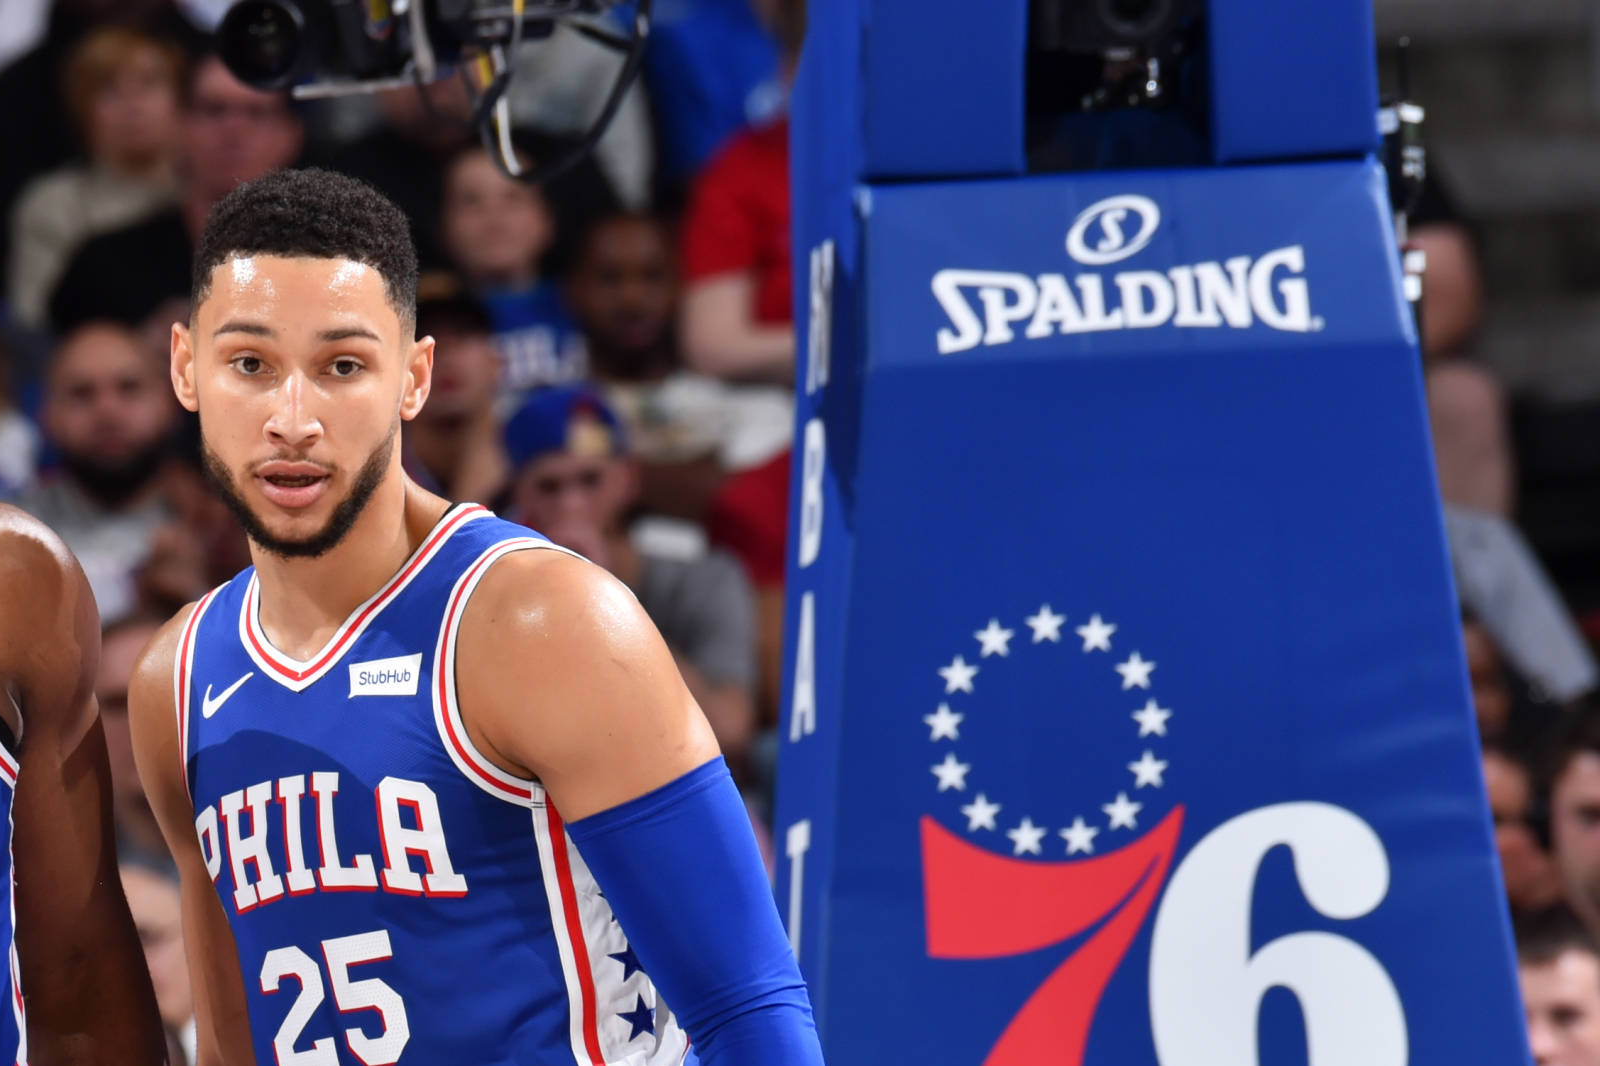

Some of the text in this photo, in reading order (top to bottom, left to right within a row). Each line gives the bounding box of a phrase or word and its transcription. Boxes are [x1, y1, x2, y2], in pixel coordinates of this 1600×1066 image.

[931, 245, 1312, 355] SPALDING
[358, 668, 411, 686] StubHub
[195, 772, 468, 915] PHILA
